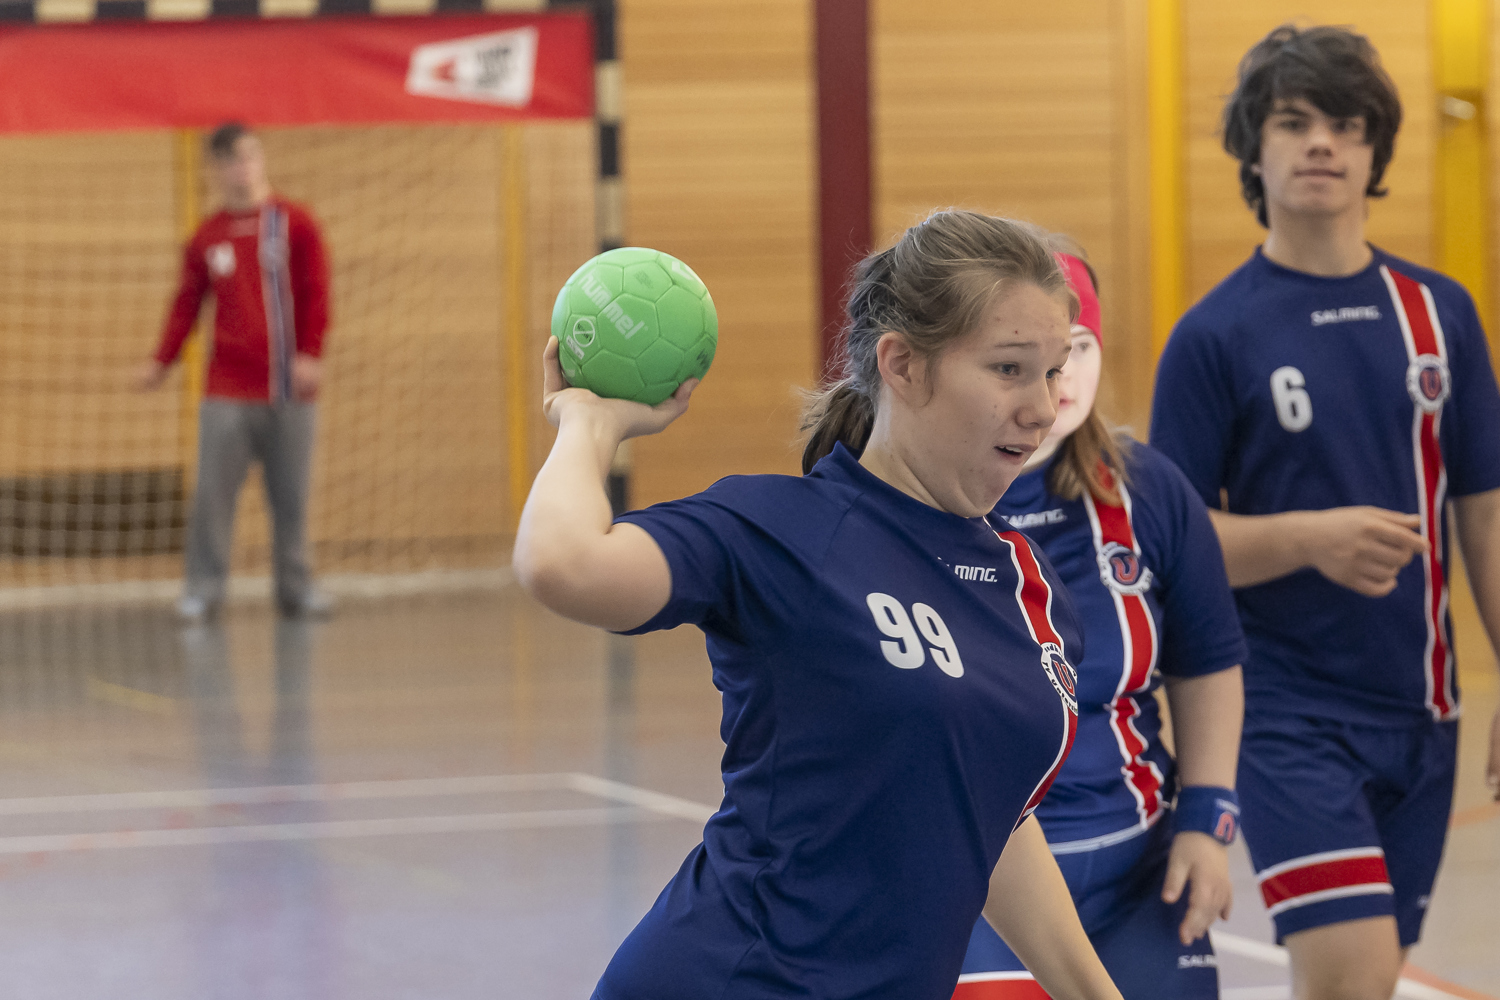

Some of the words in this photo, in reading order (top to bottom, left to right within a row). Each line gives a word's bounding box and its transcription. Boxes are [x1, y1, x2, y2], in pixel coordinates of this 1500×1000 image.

[579, 269, 645, 340] hummel
[1270, 365, 1313, 433] 6
[866, 592, 965, 678] 99
